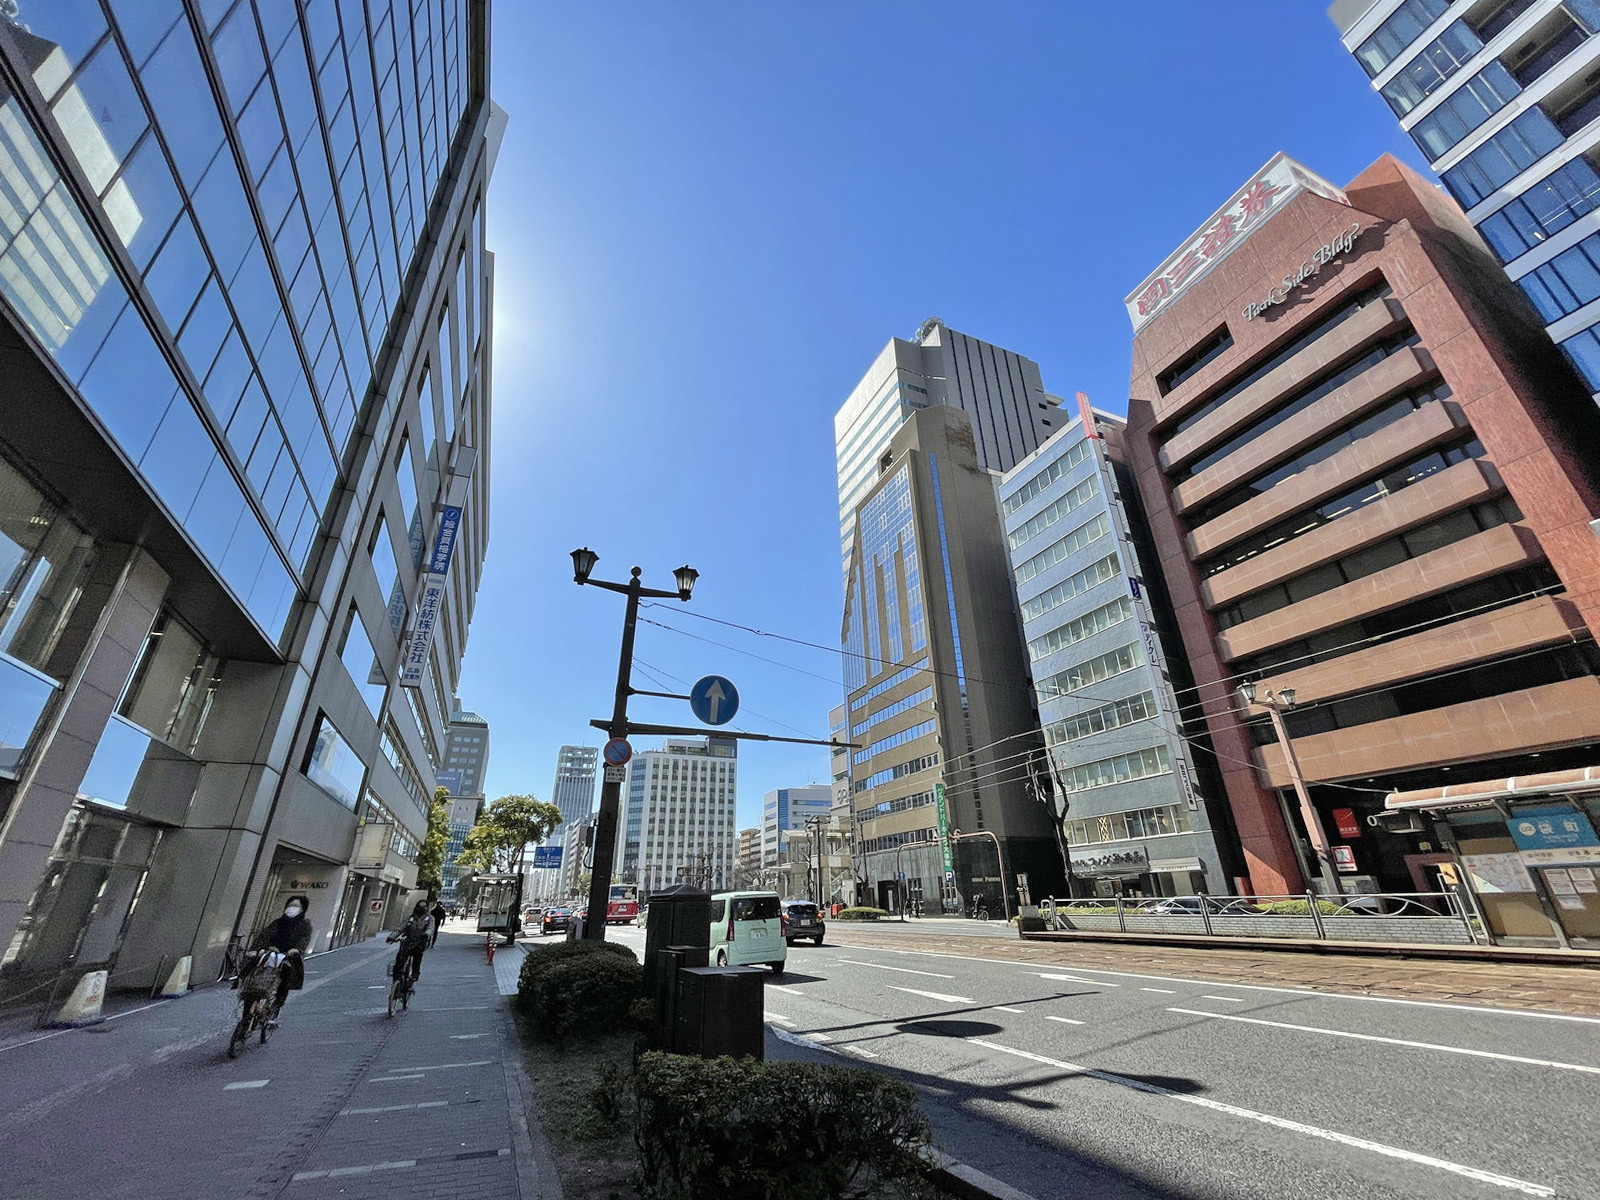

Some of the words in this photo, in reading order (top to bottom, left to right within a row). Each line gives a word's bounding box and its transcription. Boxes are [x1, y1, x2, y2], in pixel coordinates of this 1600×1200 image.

[1242, 287, 1286, 322] Park
[1280, 261, 1315, 295] Side
[409, 587, 440, 664] 東洋紡株式会社
[945, 871, 953, 882] P
